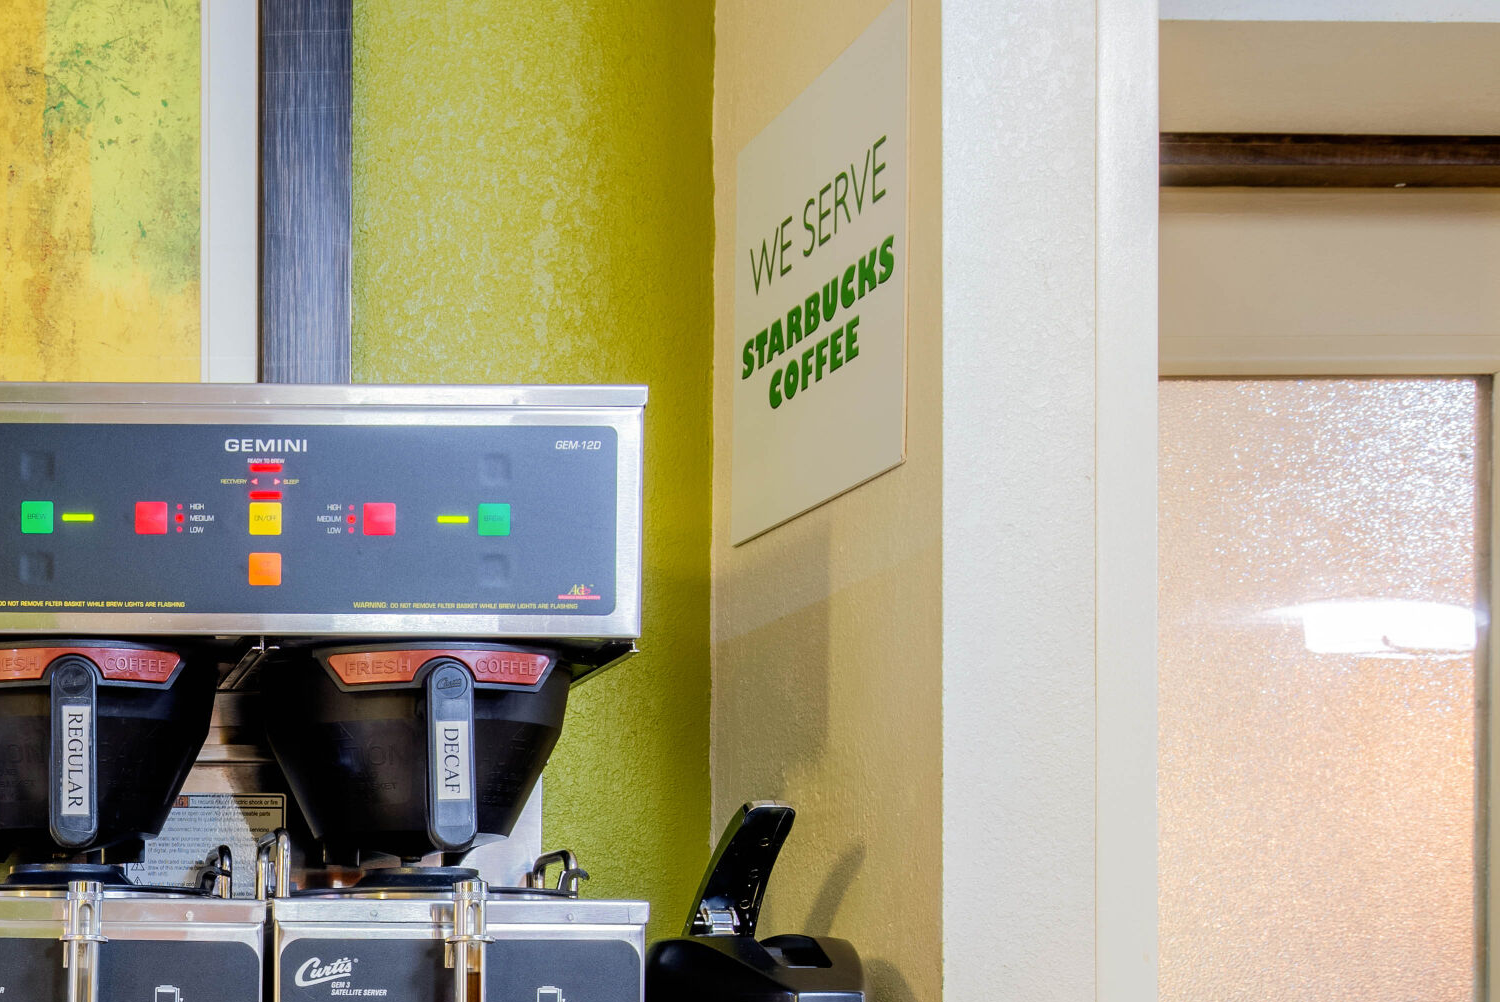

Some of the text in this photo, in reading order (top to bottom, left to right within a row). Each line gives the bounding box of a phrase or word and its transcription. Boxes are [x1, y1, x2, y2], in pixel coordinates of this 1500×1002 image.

[750, 135, 886, 296] WE SERVE
[742, 234, 894, 380] STARBUCKS
[769, 315, 860, 409] COFFEE
[225, 439, 307, 452] GEMINI
[555, 440, 601, 450] GEM-12D
[104, 657, 167, 673] COFFEE
[345, 659, 537, 676] FRESH COFFEE
[67, 713, 84, 807] REGULAR
[444, 727, 461, 794] DECAF
[295, 957, 352, 987] Curtis
